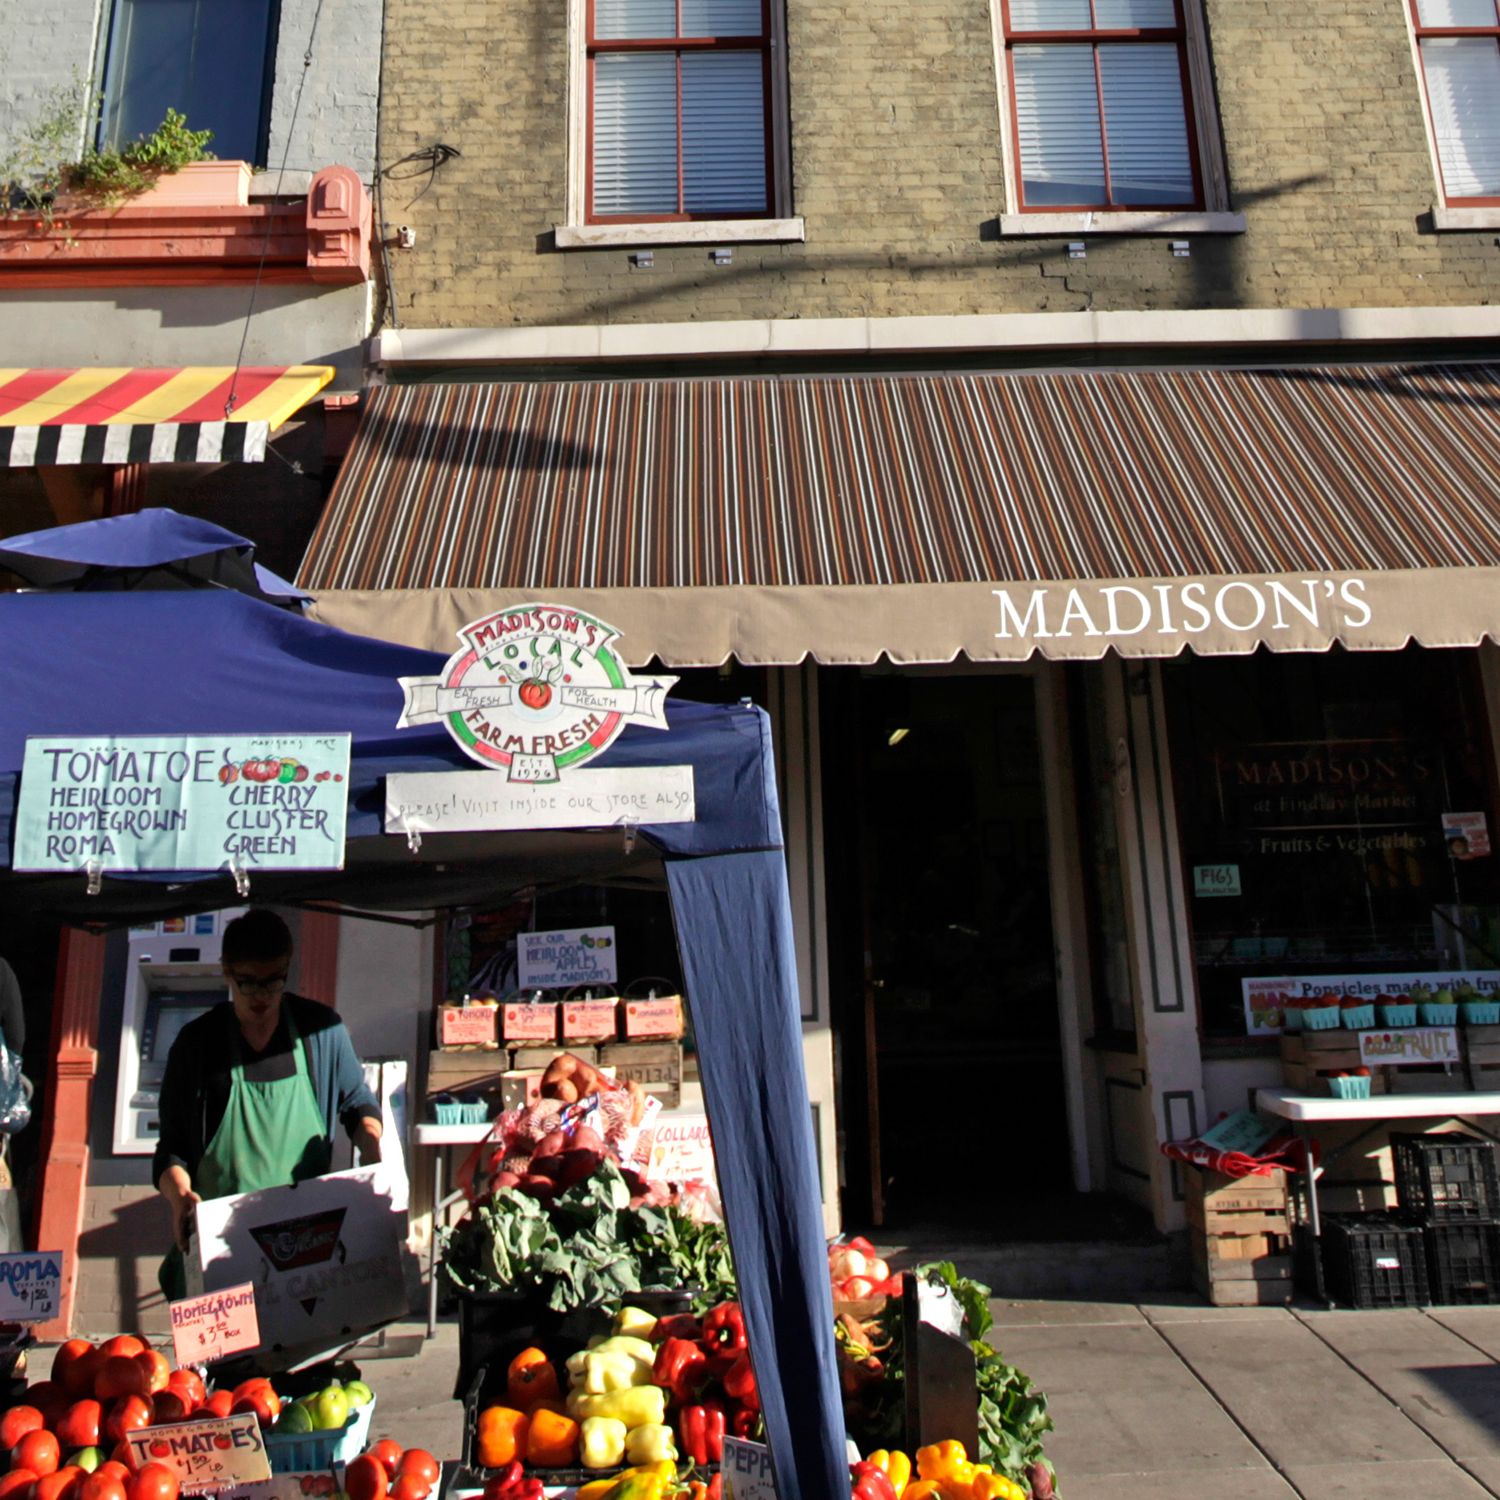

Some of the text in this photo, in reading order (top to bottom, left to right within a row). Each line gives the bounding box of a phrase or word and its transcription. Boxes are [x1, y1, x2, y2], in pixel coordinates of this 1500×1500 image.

[993, 579, 1372, 639] MADISON'S
[475, 610, 597, 647] MADISON'S
[483, 637, 583, 669] LOCAL
[454, 688, 476, 698] EAT
[465, 696, 500, 707] FRESH
[568, 688, 593, 699] FOR
[576, 696, 617, 707] HEALTH
[466, 709, 601, 754] FARM FRESH
[43, 747, 232, 787] TOMATOES
[517, 769, 551, 779] 1996
[1237, 757, 1430, 786] MADISON'S
[50, 786, 162, 814] HEIRLOOM
[228, 785, 317, 811] CHERRY
[462, 798, 499, 816] VISIT
[510, 797, 556, 815] INSIDE
[568, 797, 601, 813] OUR
[605, 794, 648, 813] STORE
[47, 809, 187, 839] HOMEGROWN
[226, 809, 335, 842] CLUSTER
[46, 835, 116, 863] ROMA
[223, 833, 296, 863] GREEN
[1261, 834, 1312, 854] Fruits
[1337, 831, 1427, 853] Vegetables
[1200, 868, 1234, 887] FIGS
[525, 935, 542, 947] SEE
[526, 944, 585, 962] HEIRLOOM
[556, 954, 597, 972] APPLES
[1301, 982, 1380, 998] Popsicles
[1386, 980, 1433, 995] made
[1436, 978, 1470, 992] with
[655, 1125, 711, 1149] COLLARD
[0, 1259, 60, 1297] ROMA
[171, 1291, 254, 1324] HOMEGROWN
[150, 1421, 235, 1437] HOMEGROWN
